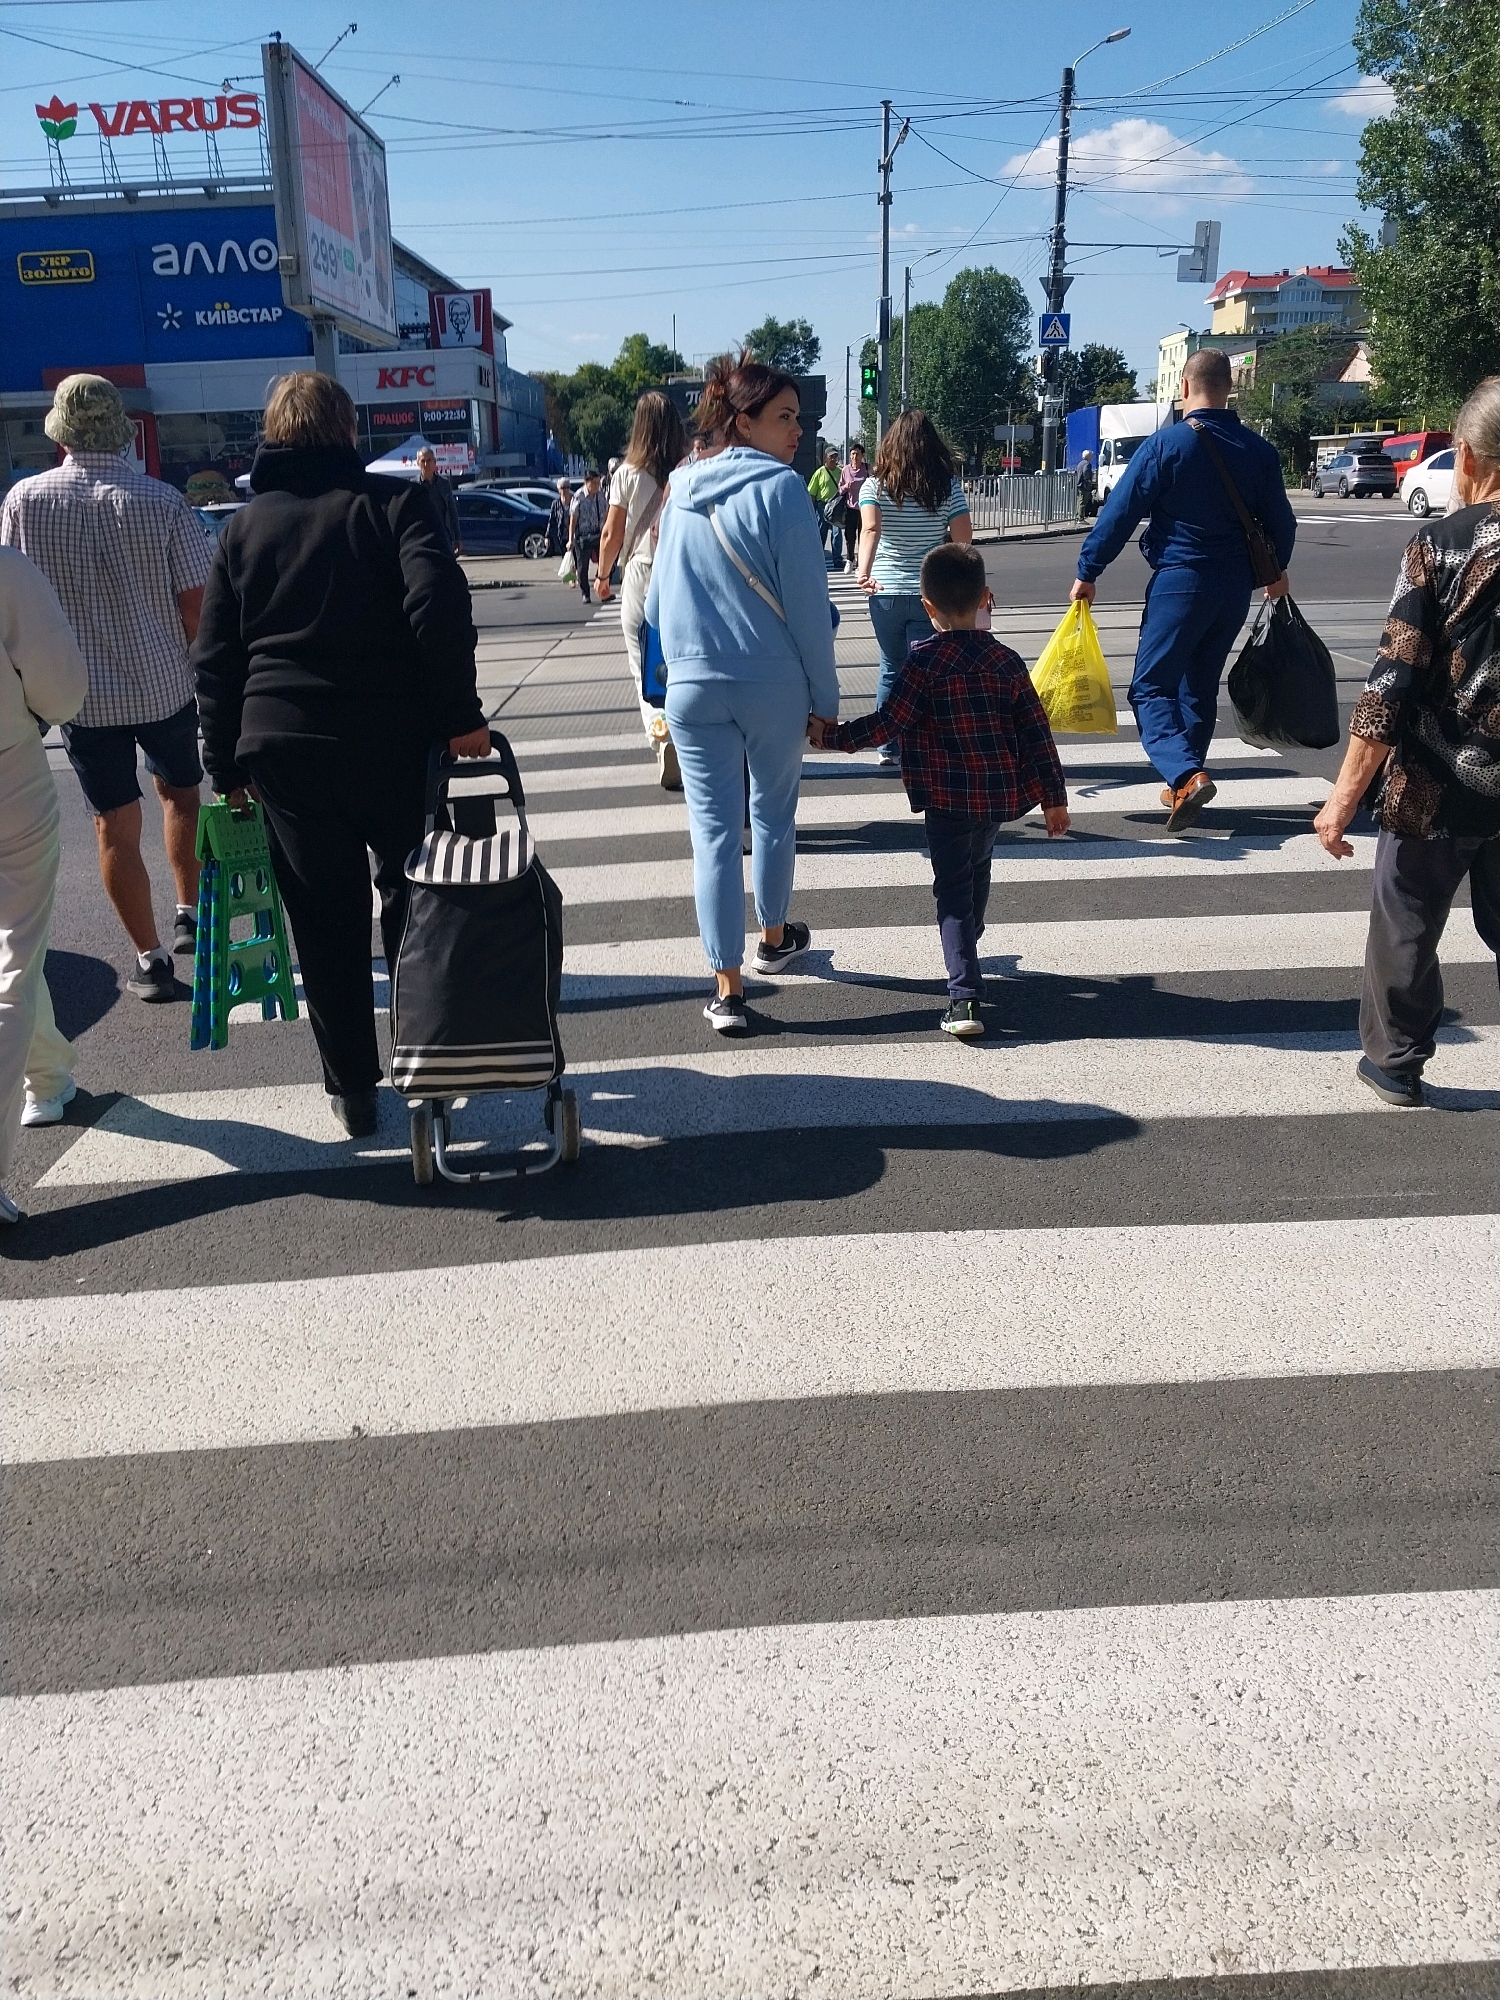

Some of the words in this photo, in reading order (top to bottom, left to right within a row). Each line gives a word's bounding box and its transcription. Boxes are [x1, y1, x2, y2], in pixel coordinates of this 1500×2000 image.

[88, 94, 261, 136] VARUS
[40, 256, 71, 267] УКР
[311, 232, 338, 280] 299
[22, 266, 92, 281] ЗОЛОТО
[195, 302, 283, 325] КИЇВСТАР
[376, 365, 435, 389] KFC
[864, 369, 876, 378] 31
